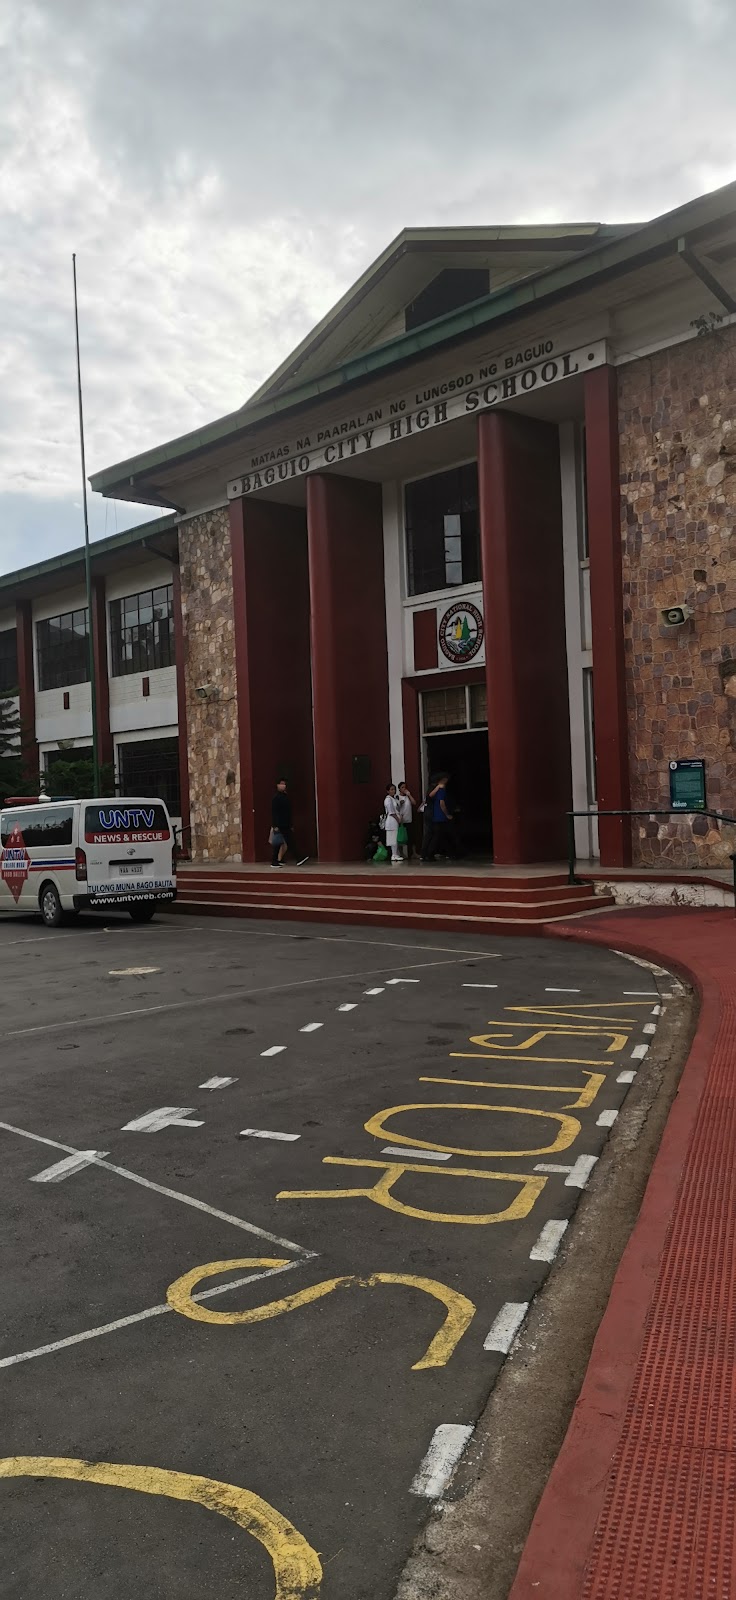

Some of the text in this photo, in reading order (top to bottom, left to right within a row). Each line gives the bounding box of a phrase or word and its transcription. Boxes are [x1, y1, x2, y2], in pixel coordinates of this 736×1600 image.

[251, 340, 554, 468] MATAAS NA PAARALAN NG LUNGSOD NG BAGUIO
[240, 354, 579, 494] BAGUIO CITY HIGH SCHOOL
[99, 809, 155, 829] UNTV
[94, 832, 163, 843] NEWS & RESCUE
[88, 880, 173, 893] TULONG MUNA BAGO BALITA
[90, 891, 174, 905] www.untvweb.com
[166, 1001, 658, 1370] VISITORS
